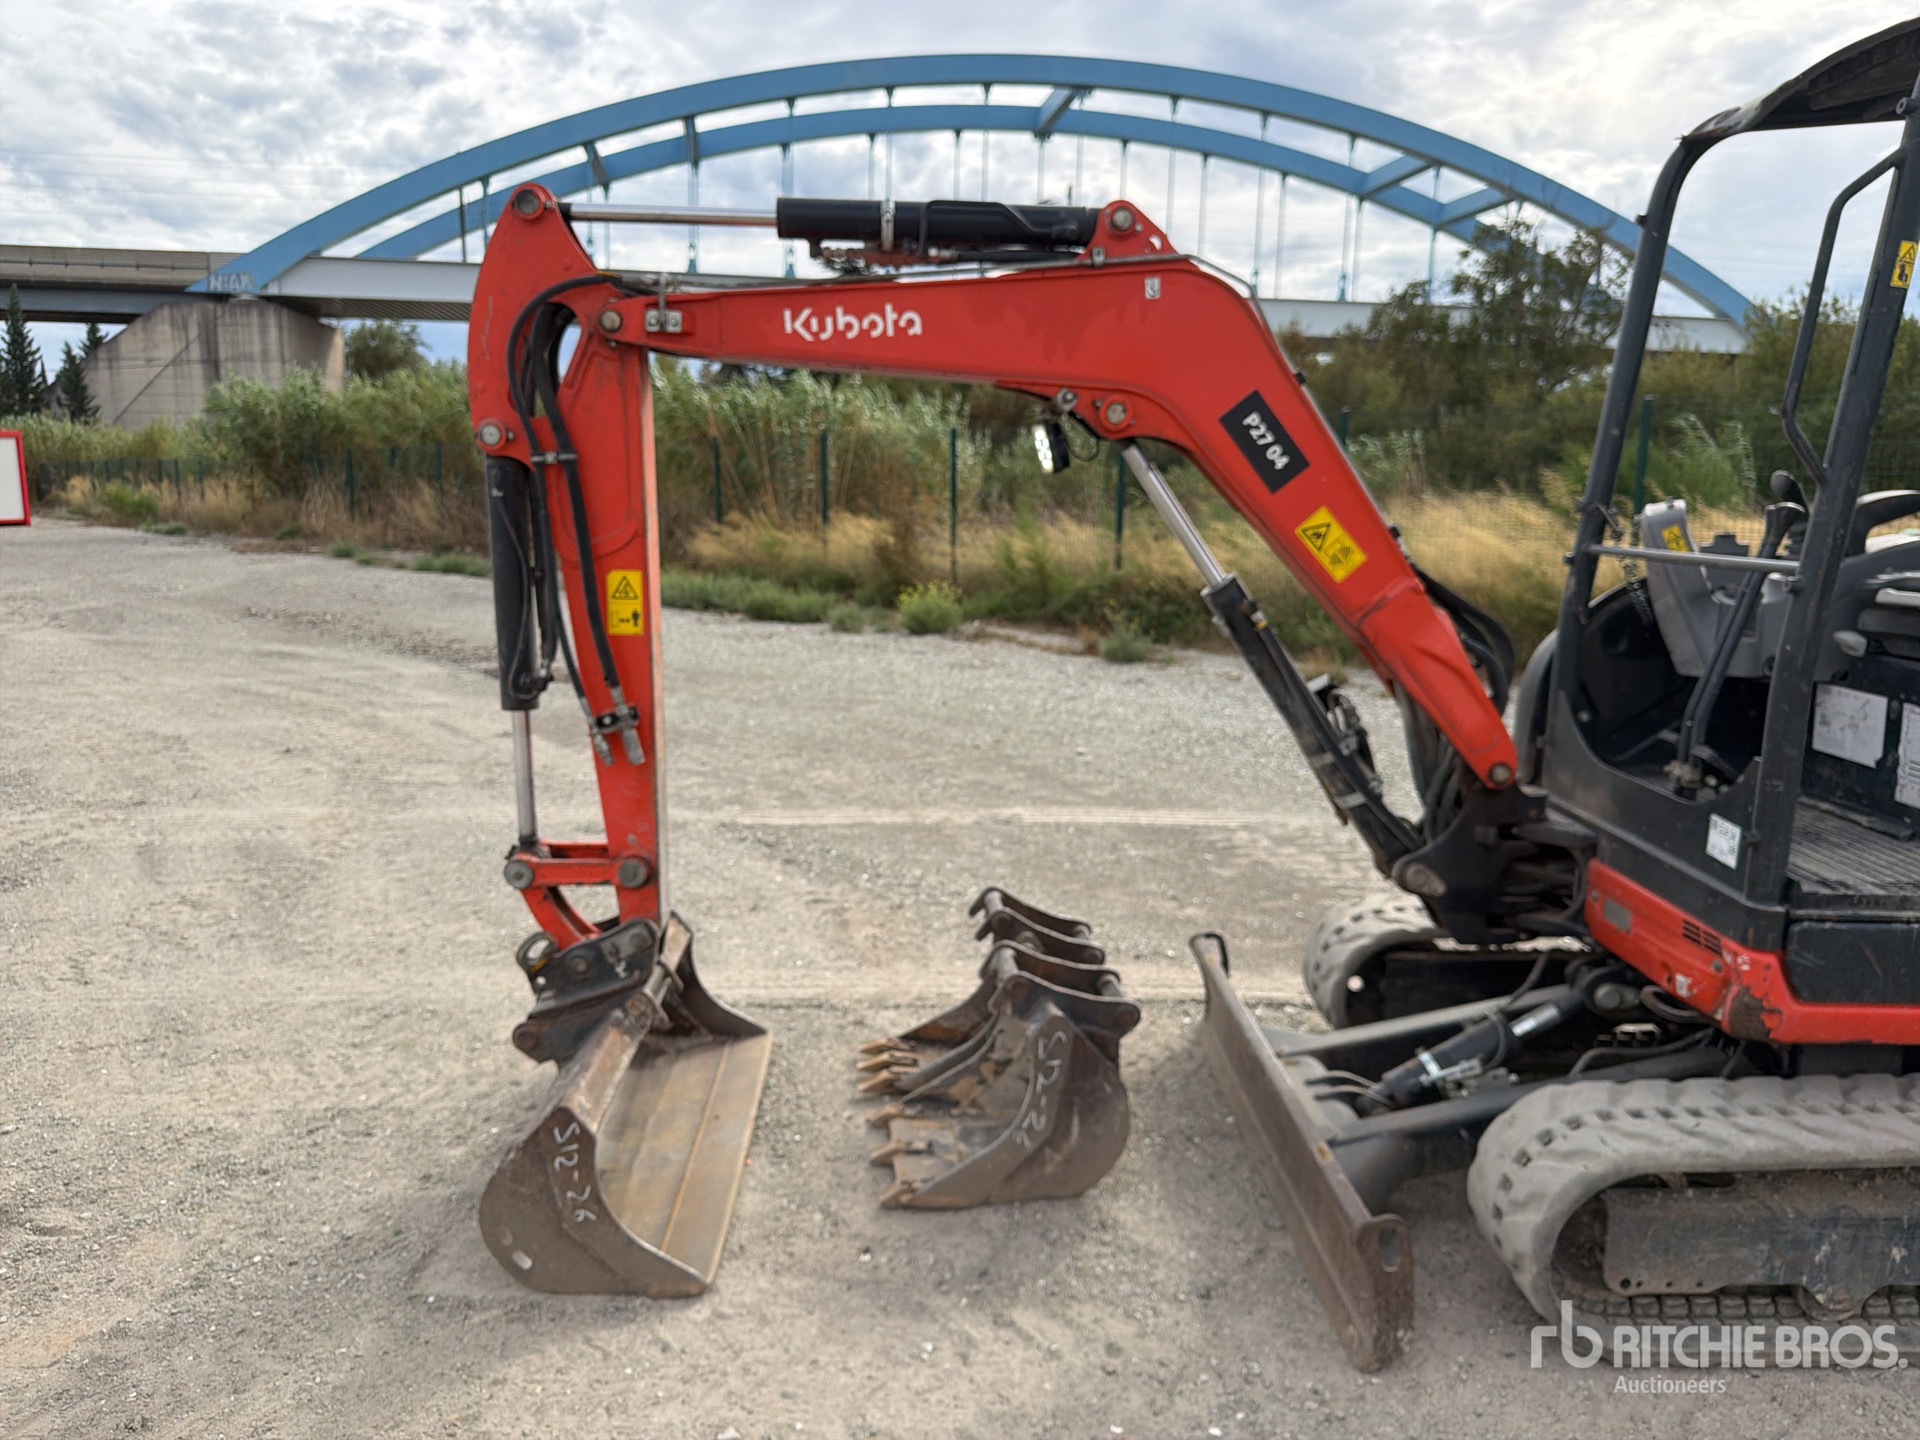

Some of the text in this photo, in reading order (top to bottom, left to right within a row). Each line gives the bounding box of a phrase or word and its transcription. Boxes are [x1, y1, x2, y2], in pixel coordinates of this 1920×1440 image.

[783, 303, 923, 342] Kubota
[1242, 411, 1291, 470] P27 04
